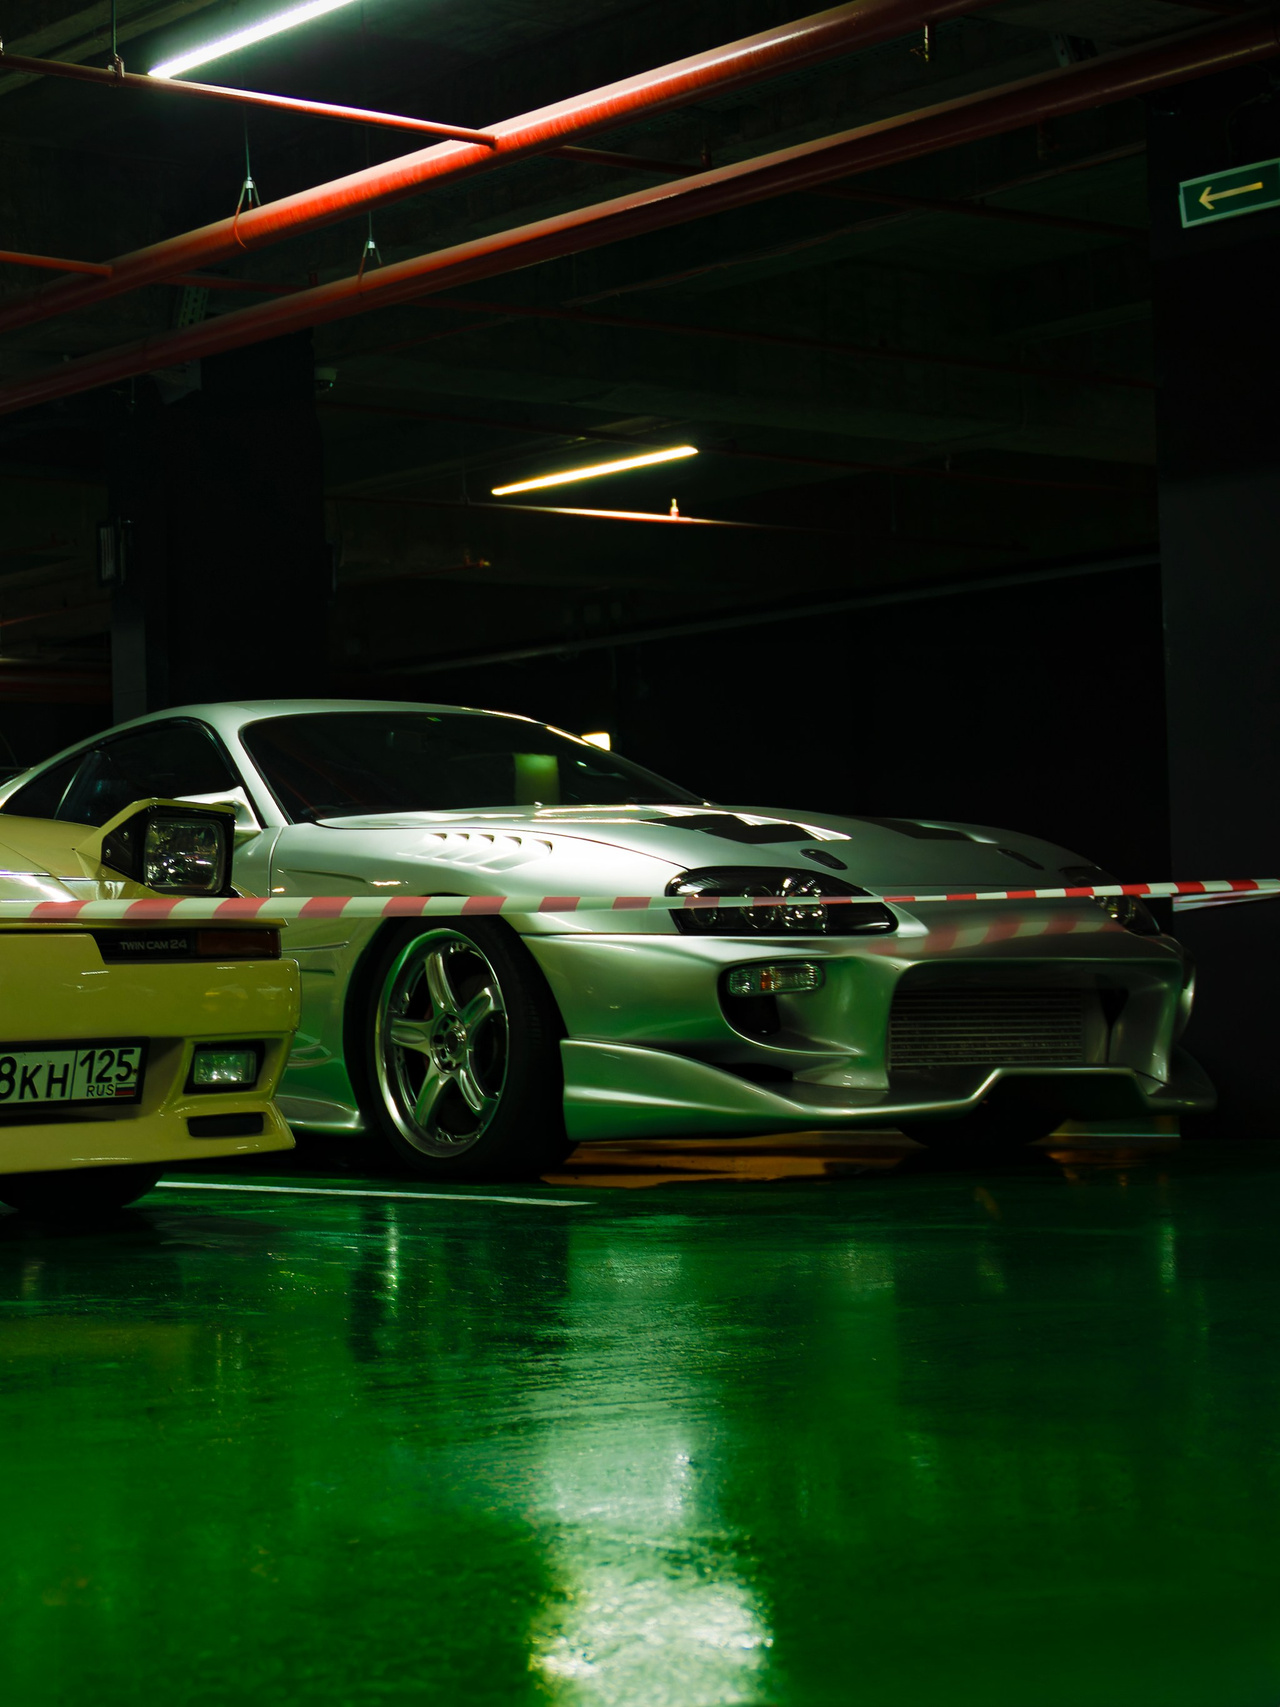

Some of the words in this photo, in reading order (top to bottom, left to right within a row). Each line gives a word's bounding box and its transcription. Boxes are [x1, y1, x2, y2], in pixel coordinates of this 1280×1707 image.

[120, 941, 145, 951] TWIN
[146, 940, 169, 950] CAM
[170, 939, 188, 949] 24
[79, 1048, 135, 1084] 125
[86, 1084, 115, 1097] RUS
